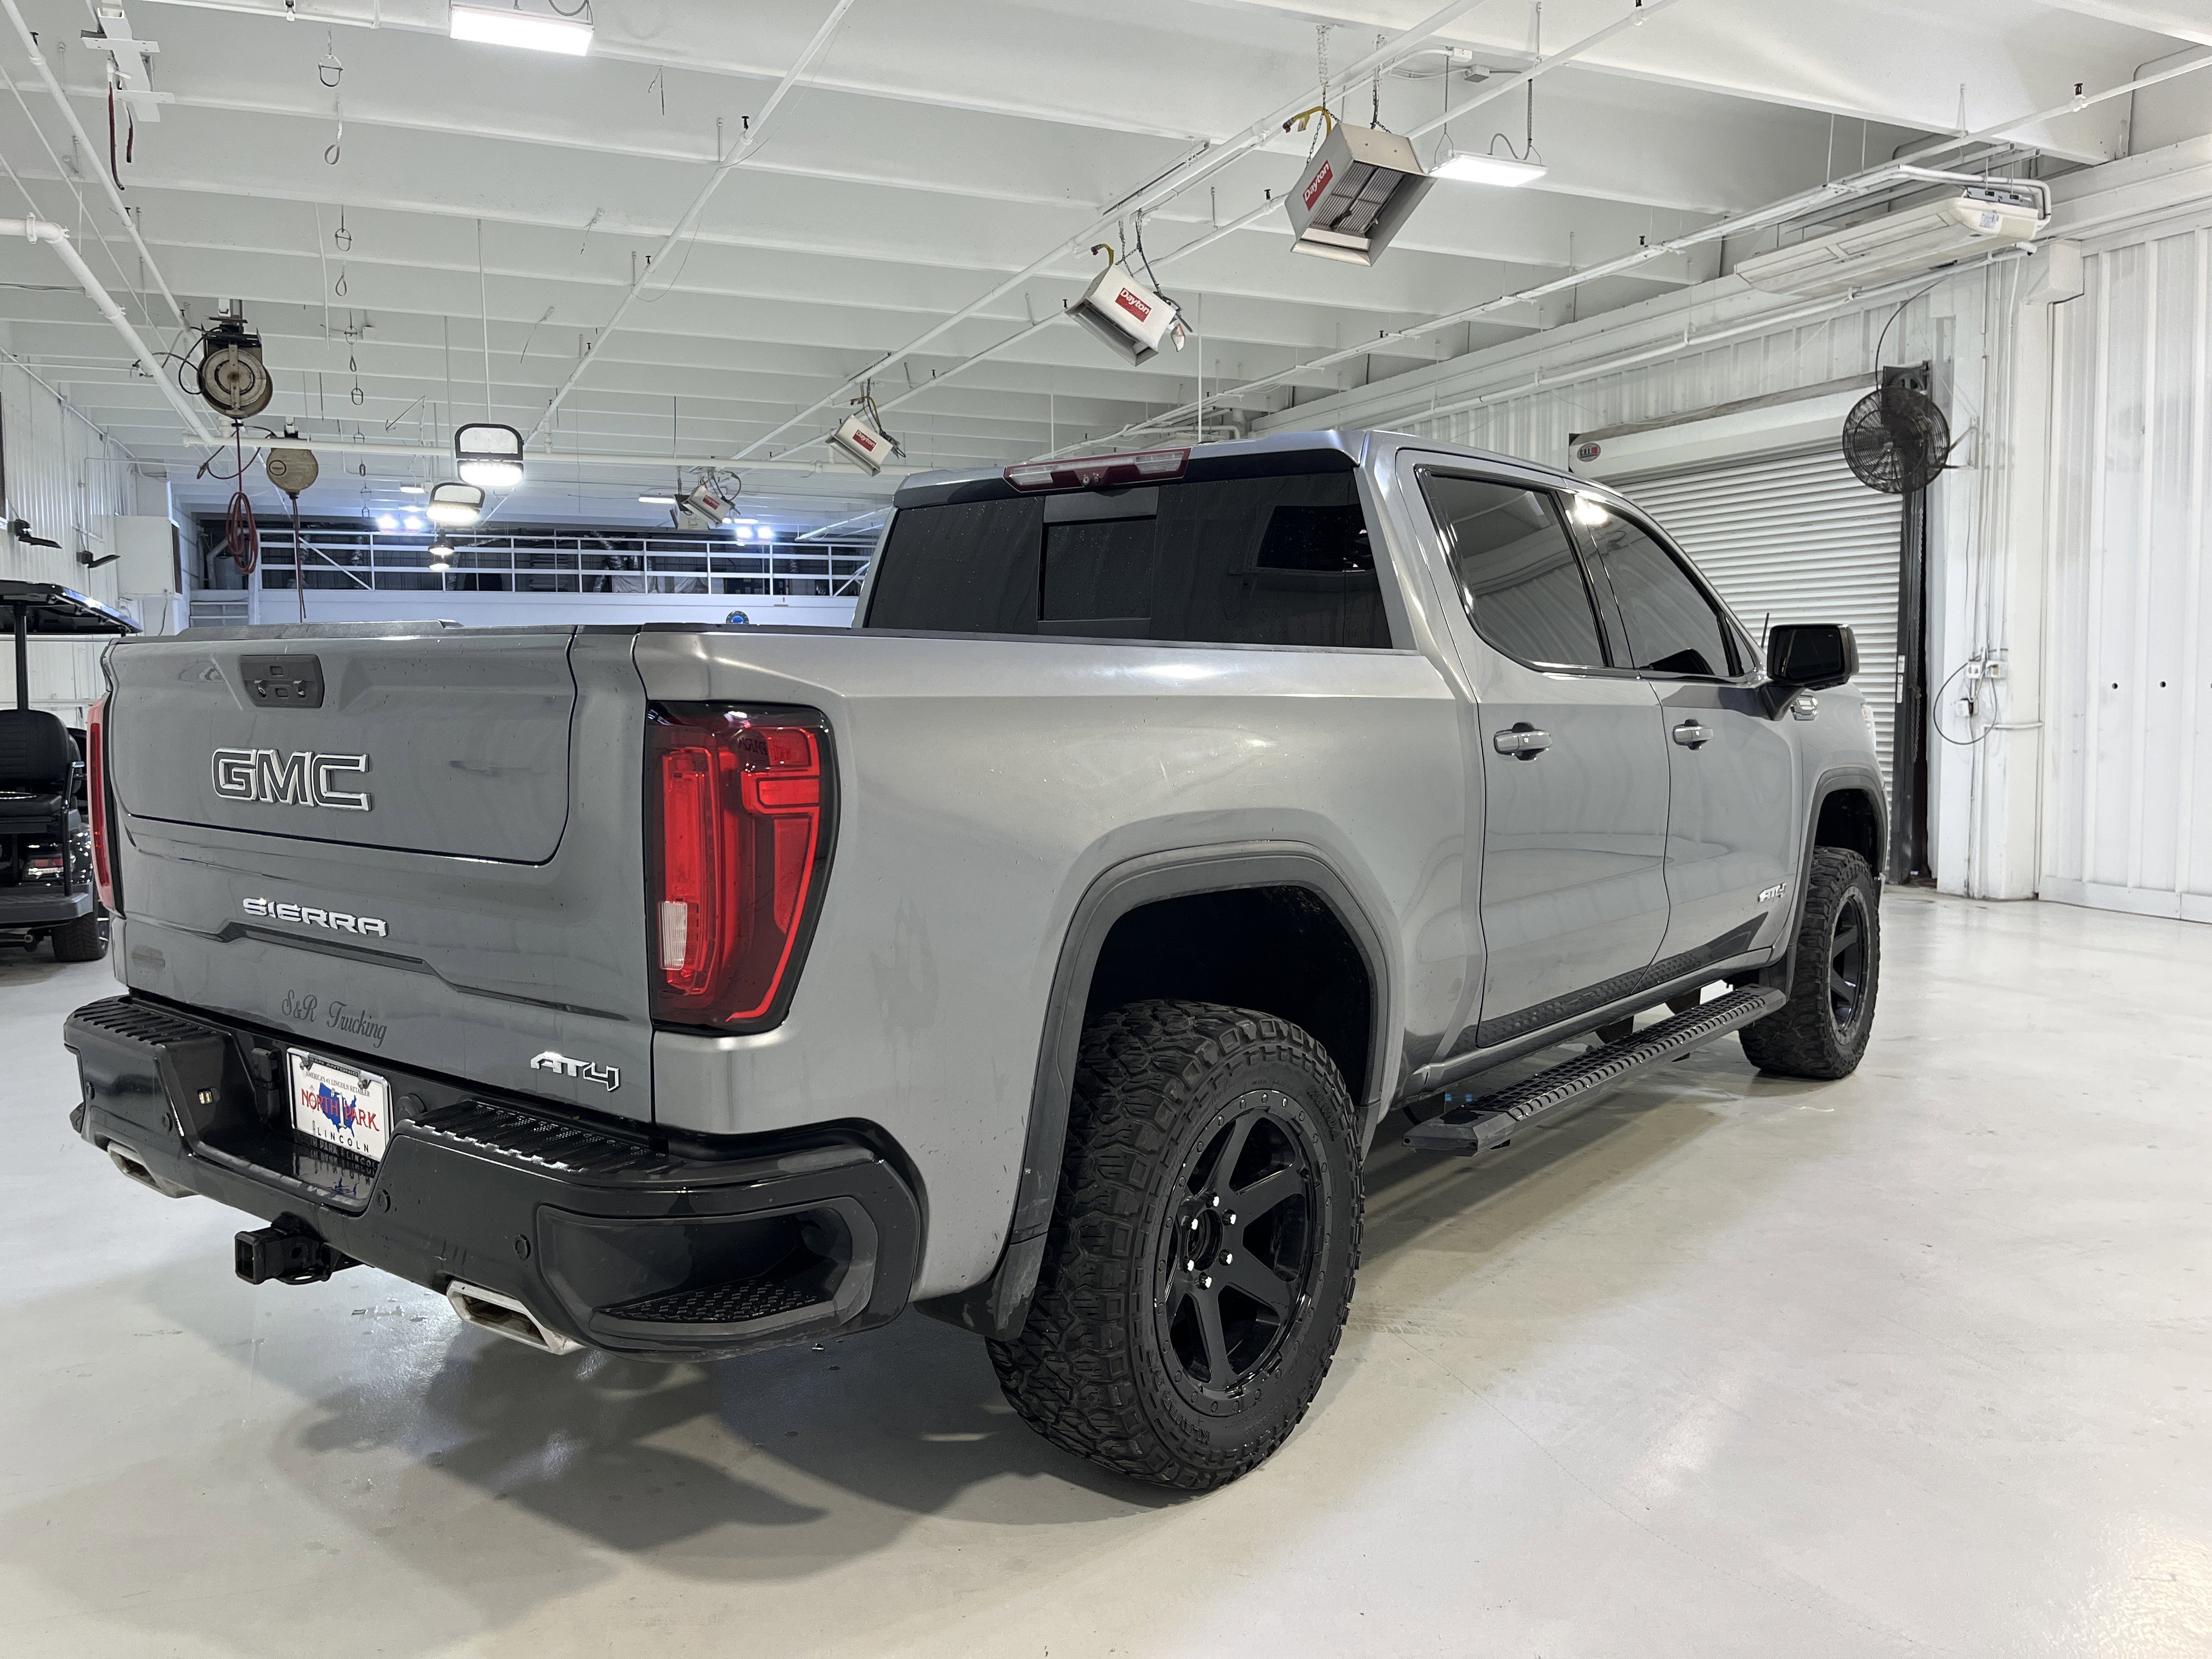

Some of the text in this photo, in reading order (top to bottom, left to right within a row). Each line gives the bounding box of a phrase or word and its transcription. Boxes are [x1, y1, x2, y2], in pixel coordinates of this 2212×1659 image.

[1304, 163, 1329, 202] Dayton
[1120, 289, 1150, 315] Dayton
[856, 430, 876, 448] Dayton
[212, 746, 371, 811] GMC
[242, 898, 388, 938] SIERRA
[282, 989, 388, 1048] S&R Trucking
[309, 1057, 358, 1076] SAN ANTONIO
[530, 1050, 620, 1092] AT4
[331, 1079, 350, 1091] LINCOLN
[301, 1088, 380, 1132] NORTH PARK
[317, 1126, 369, 1153] LINCOLN
[347, 1151, 377, 1170] LINCOL
